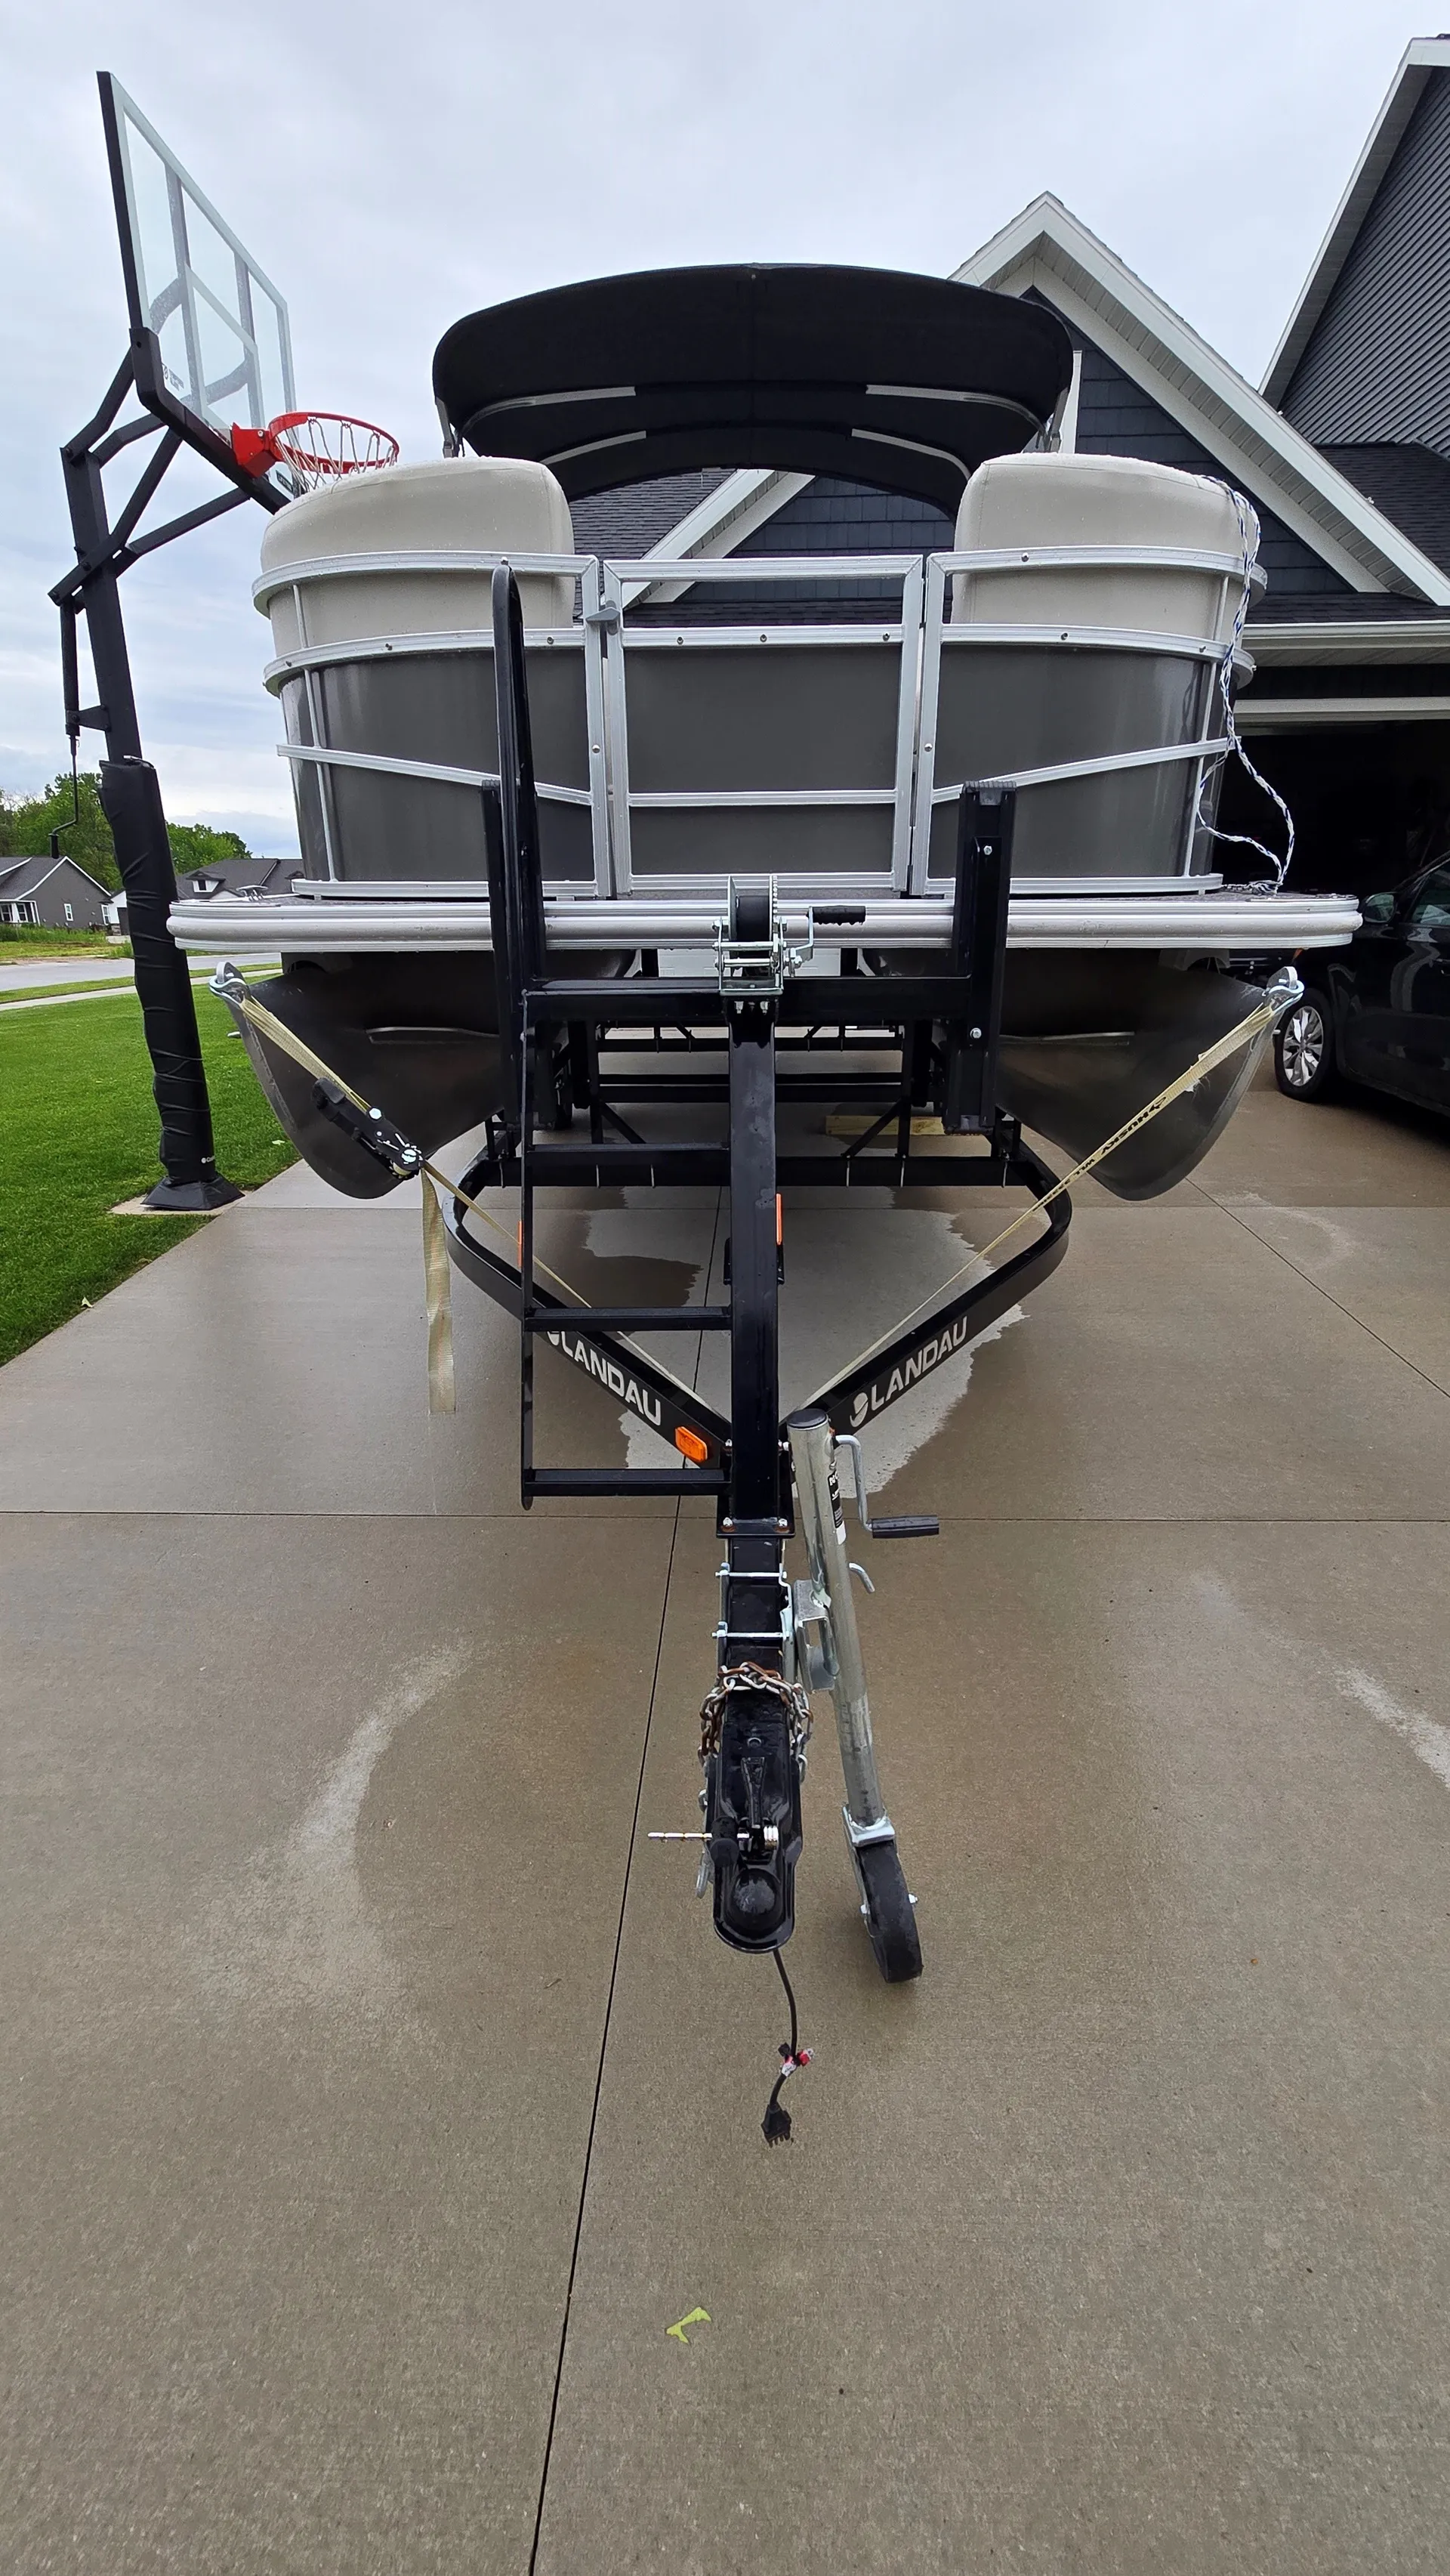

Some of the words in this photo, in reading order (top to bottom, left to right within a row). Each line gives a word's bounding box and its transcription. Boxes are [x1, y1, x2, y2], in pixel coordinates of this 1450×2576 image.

[1101, 1111, 1149, 1155] HUSKY
[561, 1330, 661, 1425] LANDAU
[872, 1316, 967, 1410] LANDAU
